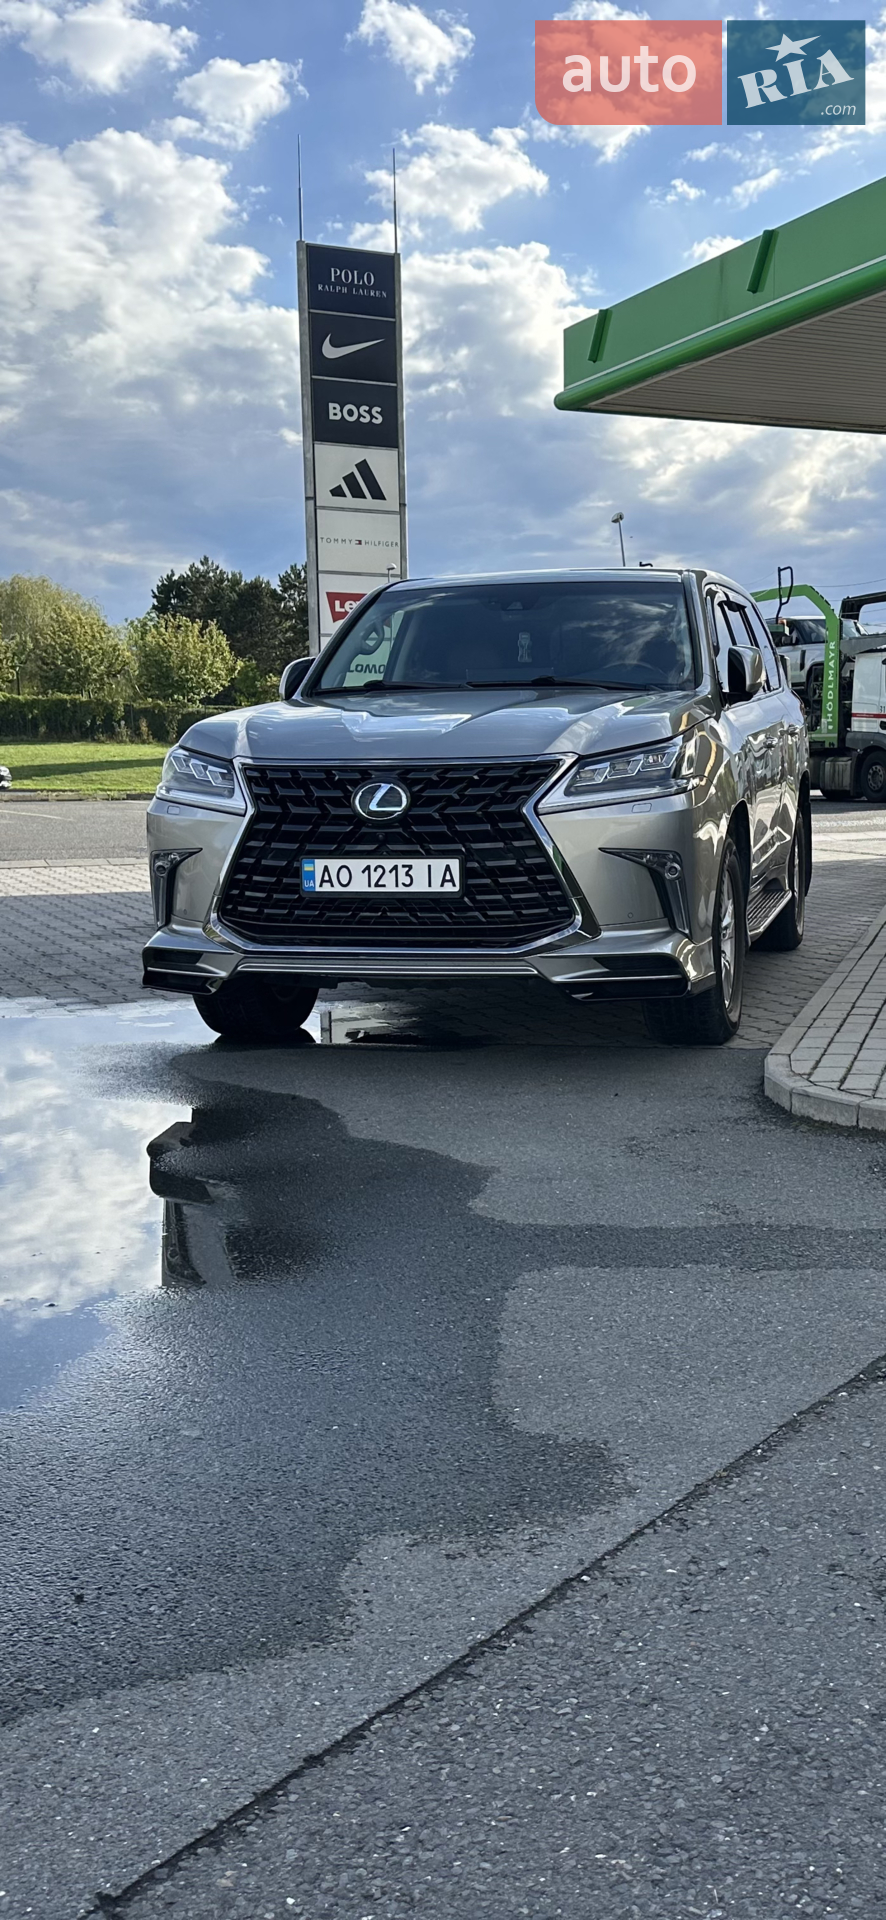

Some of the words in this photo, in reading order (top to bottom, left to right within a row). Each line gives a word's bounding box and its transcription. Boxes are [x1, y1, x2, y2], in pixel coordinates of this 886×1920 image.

[330, 267, 375, 287] POLO
[317, 283, 348, 294] RALPH
[352, 287, 388, 299] LAUREN
[328, 402, 383, 425] BOSS
[320, 536, 352, 545] TOMMY
[364, 540, 399, 548] HILFIGER
[334, 600, 361, 612] Le
[826, 641, 836, 722] HÖDLMAYR
[304, 879, 315, 888] UA
[319, 864, 353, 888] AO
[361, 864, 414, 888] 1213
[427, 864, 457, 888] IA
